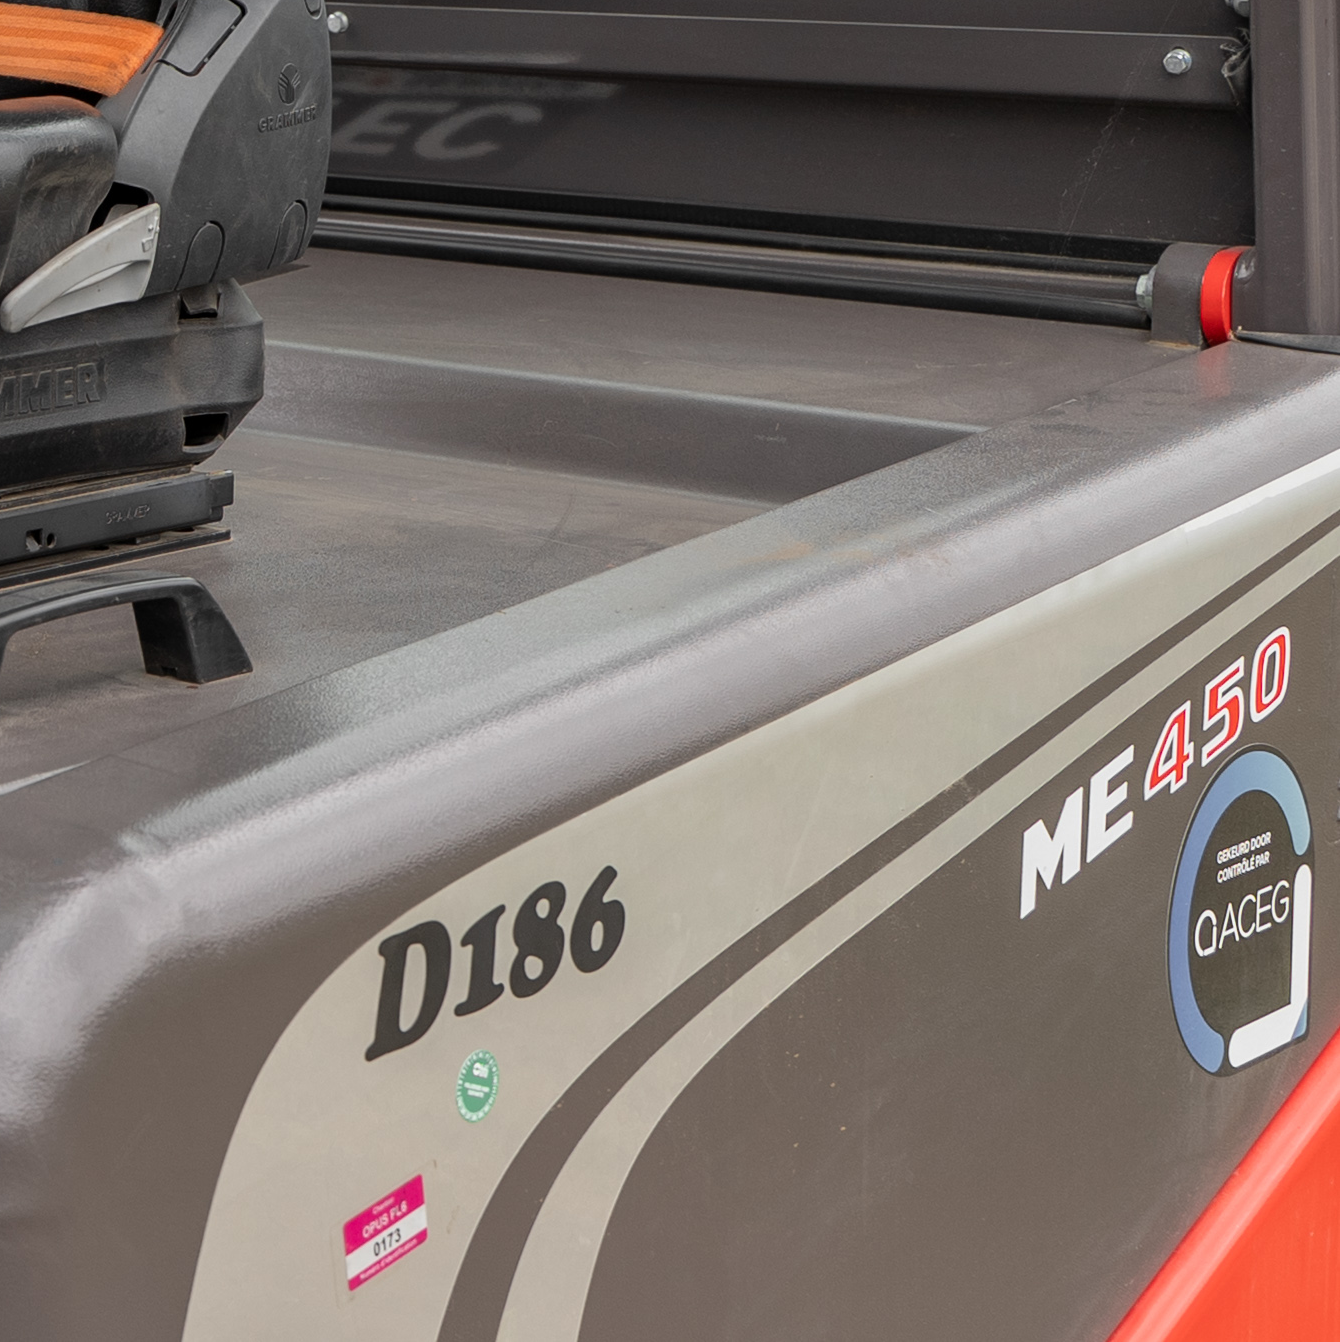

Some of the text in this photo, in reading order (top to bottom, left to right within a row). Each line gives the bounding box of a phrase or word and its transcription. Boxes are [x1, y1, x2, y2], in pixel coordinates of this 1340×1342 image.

[257, 103, 318, 133] GRAMMER
[329, 96, 543, 159] EC
[1217, 831, 1272, 864] GEKEURD DOOR
[1217, 850, 1271, 884] CONTRÔLÉ PAR
[1194, 879, 1290, 957] QACEG
[364, 865, 626, 1062] D186
[362, 1213, 389, 1238] OPUS
[373, 1227, 401, 1256] 0173
